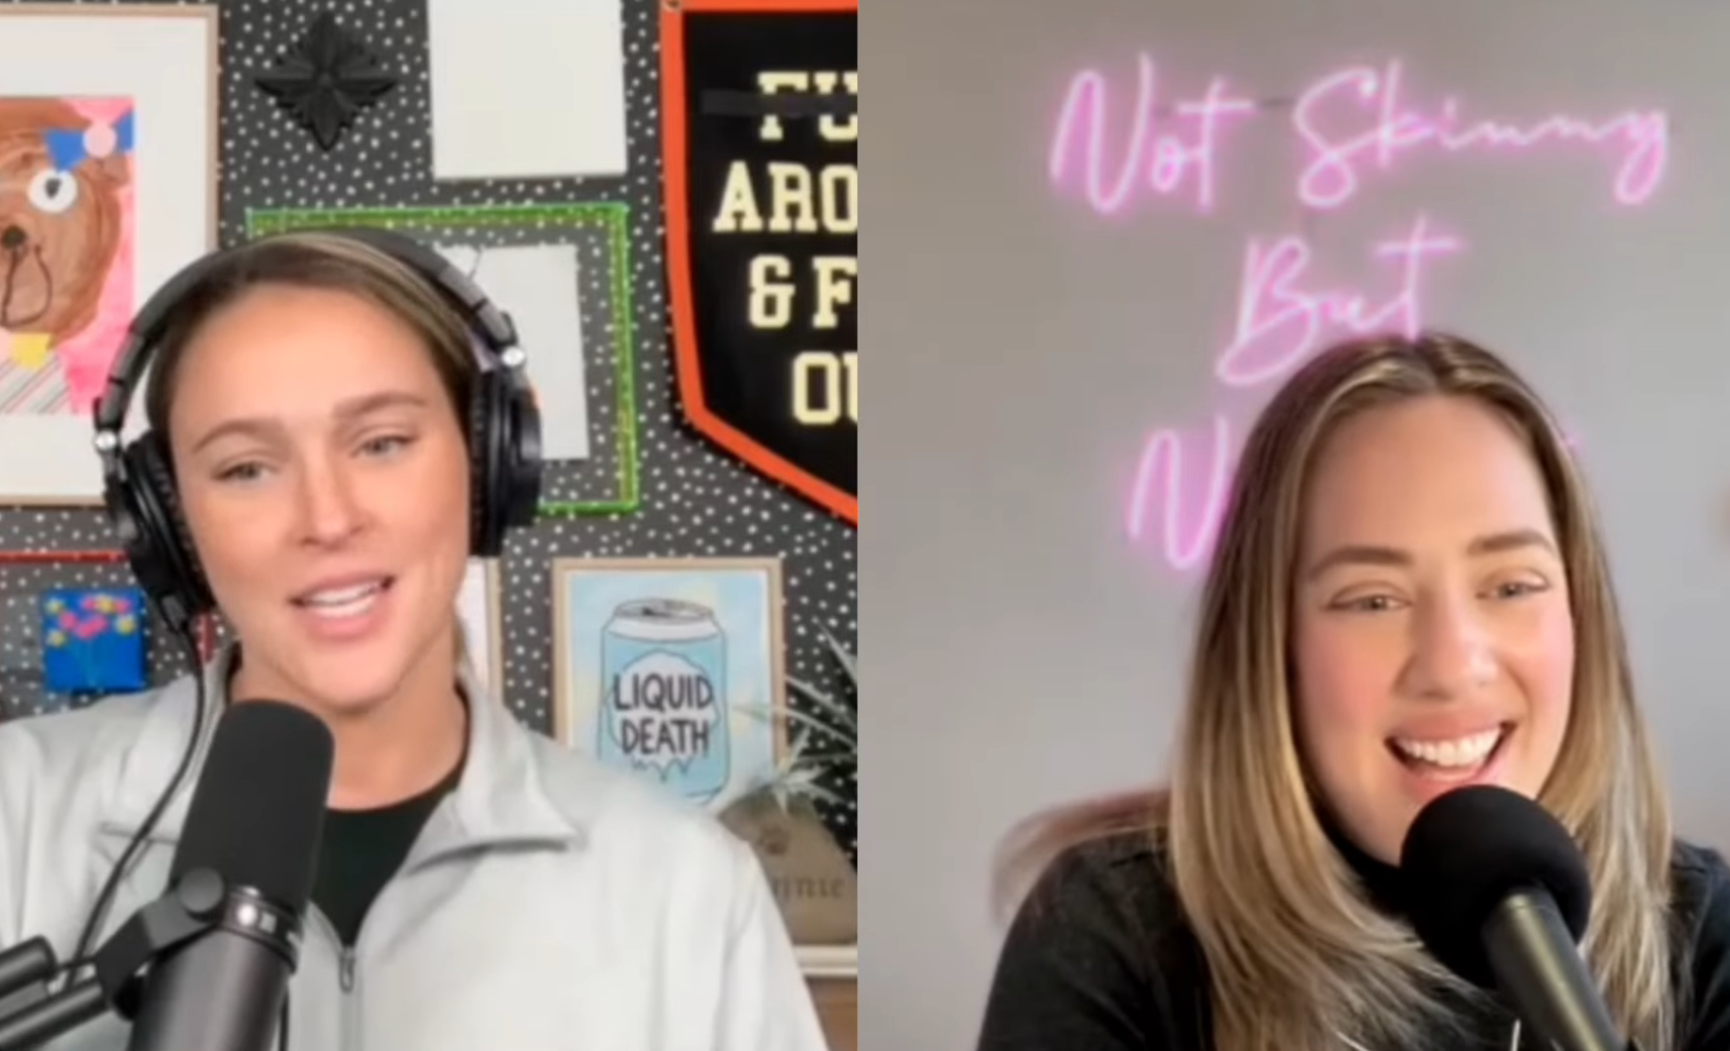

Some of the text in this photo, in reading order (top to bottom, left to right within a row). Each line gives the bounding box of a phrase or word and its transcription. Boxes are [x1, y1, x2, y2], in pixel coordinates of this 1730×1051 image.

[1049, 51, 1670, 213] Not Skinny
[749, 254, 795, 328] &
[1216, 214, 1462, 384] But
[612, 673, 715, 712] LIQUID
[621, 718, 709, 757] DEATH
